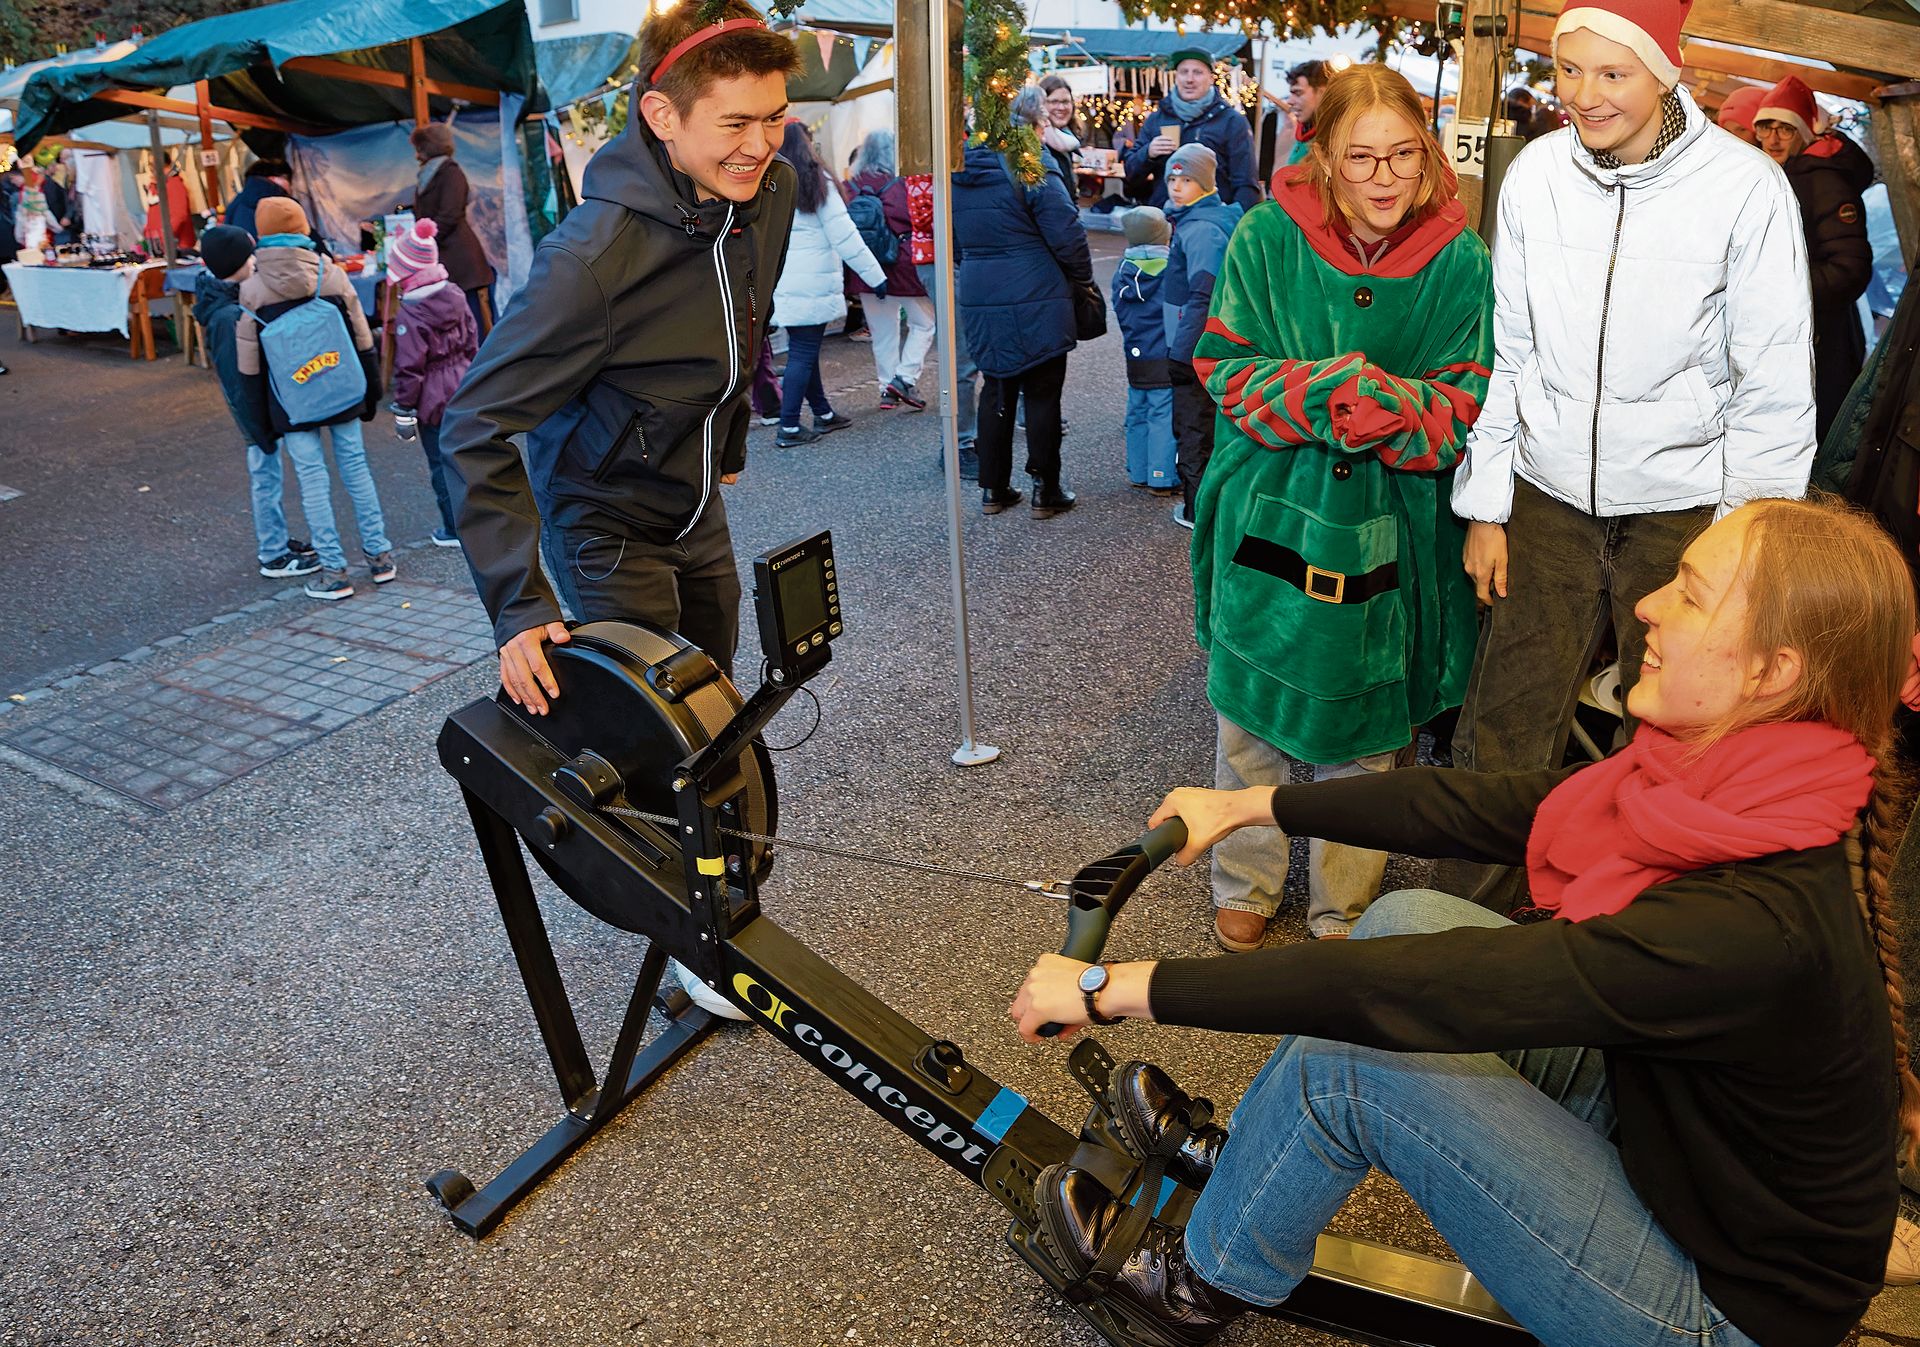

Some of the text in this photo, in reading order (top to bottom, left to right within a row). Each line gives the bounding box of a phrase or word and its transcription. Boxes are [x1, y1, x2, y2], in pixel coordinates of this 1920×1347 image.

[1456, 134, 1486, 165] 55
[293, 352, 340, 384] SMYTHS
[794, 1023, 988, 1165] concept
